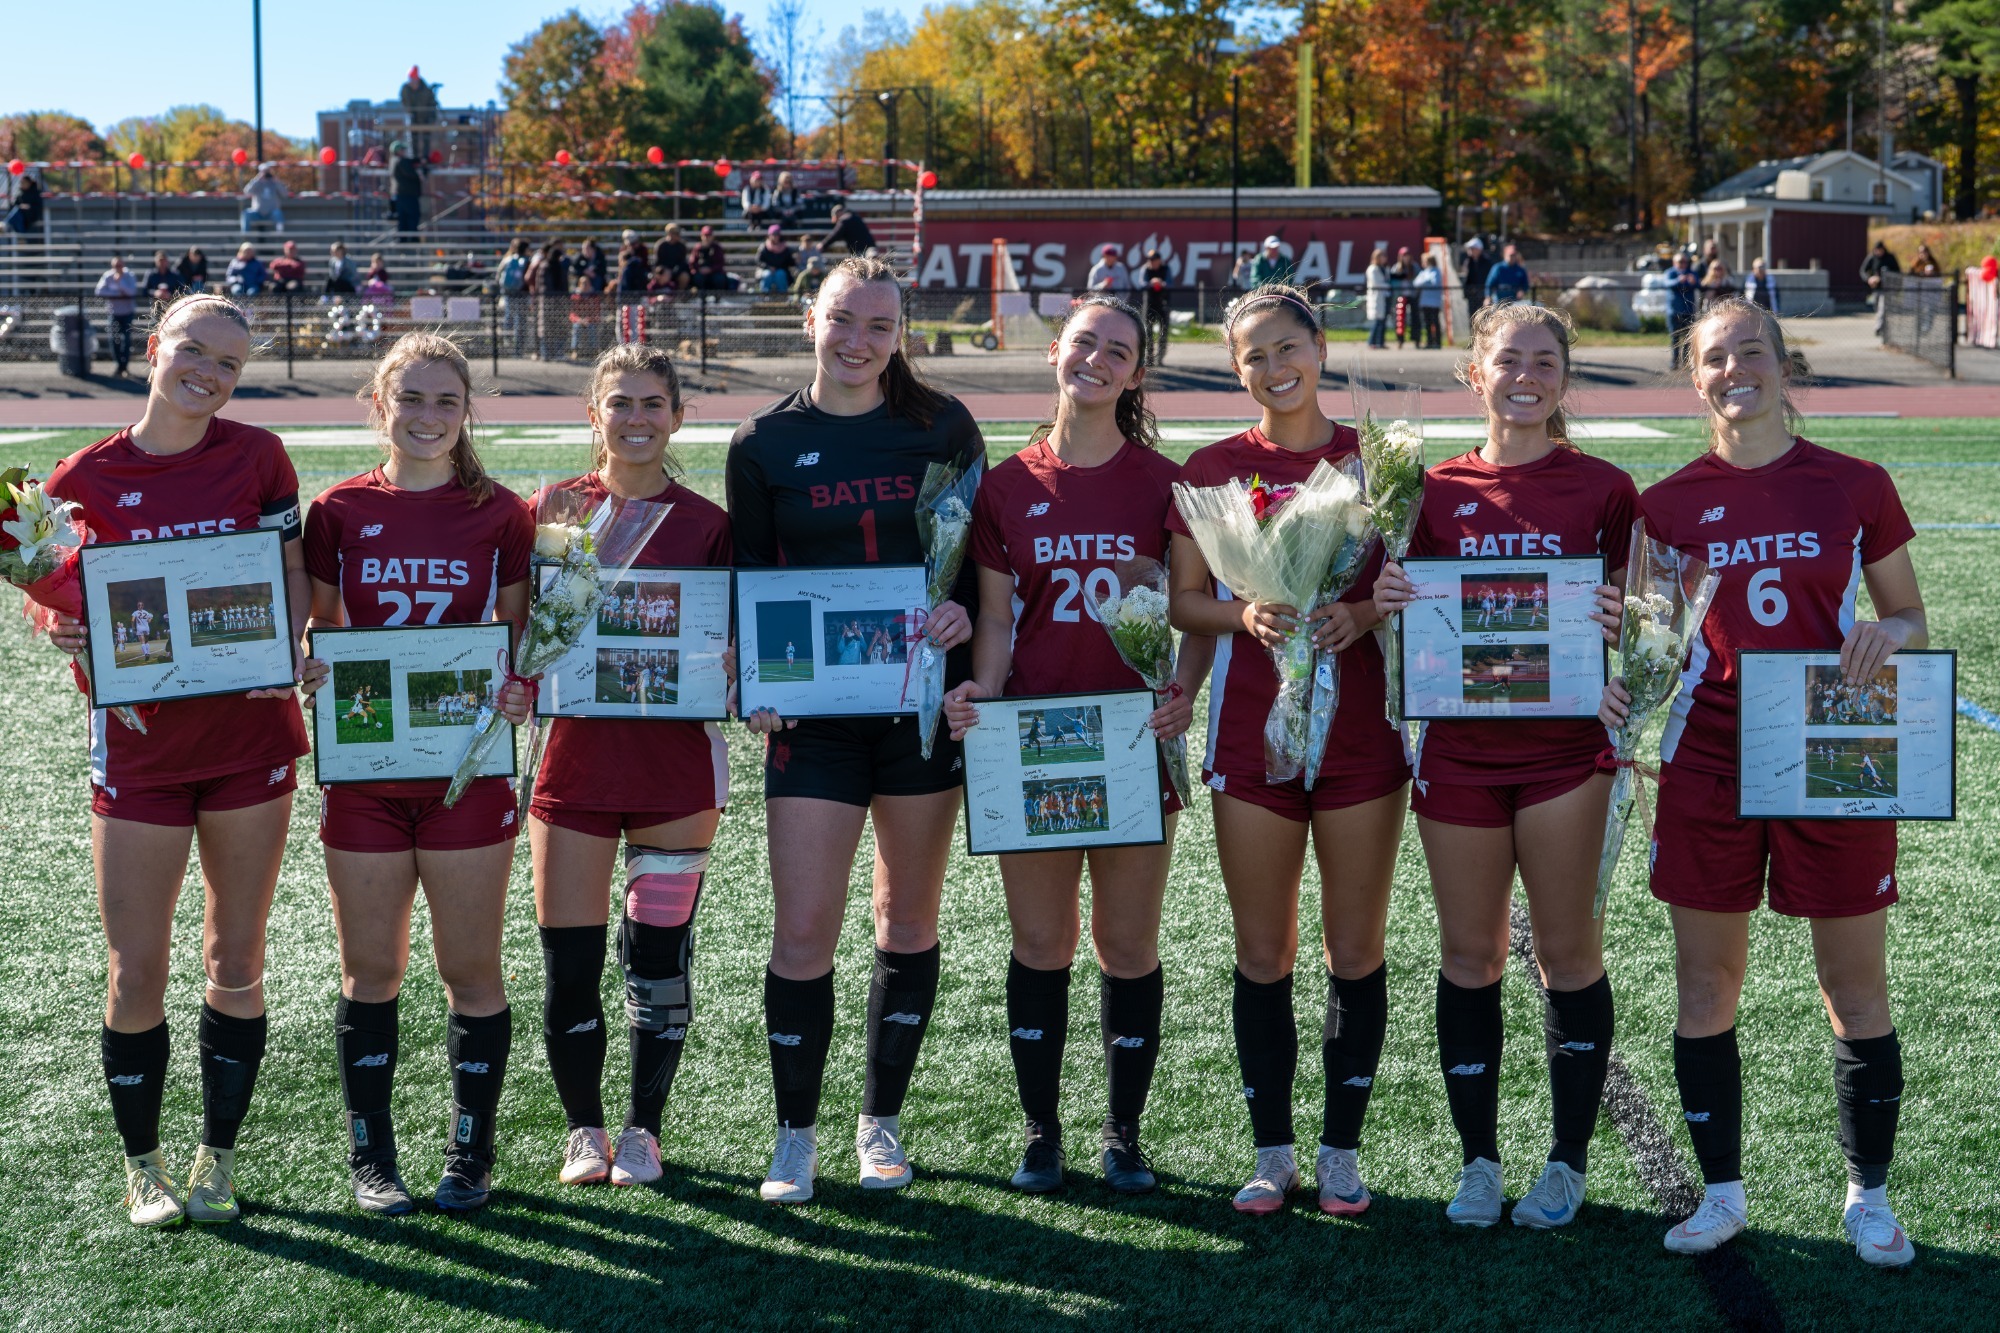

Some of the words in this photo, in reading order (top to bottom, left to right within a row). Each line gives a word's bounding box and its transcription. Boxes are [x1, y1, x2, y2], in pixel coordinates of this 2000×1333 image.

[895, 243, 1067, 288] ATES
[809, 474, 916, 509] BATES
[857, 509, 880, 562] 1
[1034, 534, 1136, 564] BATES
[1459, 533, 1562, 557] BATES
[1707, 531, 1821, 568] BATES
[361, 558, 470, 585] BATES
[377, 590, 453, 626] 27
[1051, 567, 1122, 623] 20
[1432, 606, 1445, 618] Alex
[1747, 567, 1788, 627] 6
